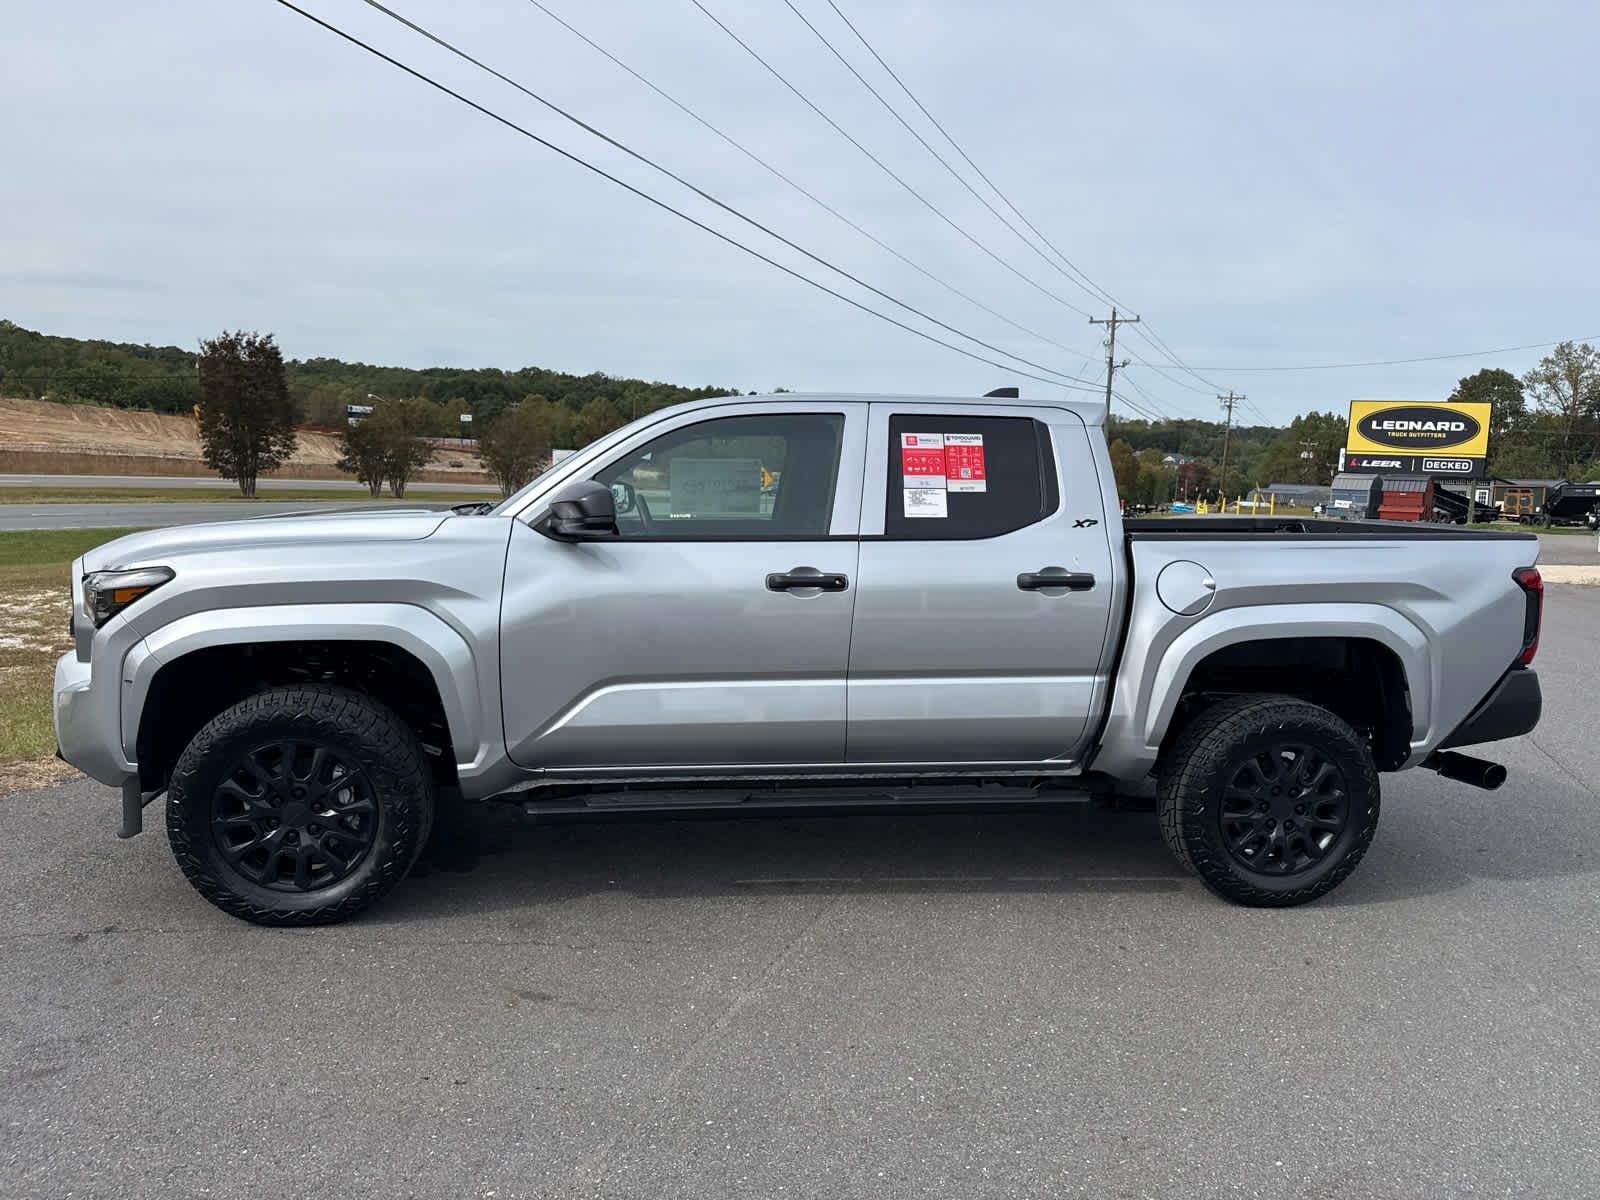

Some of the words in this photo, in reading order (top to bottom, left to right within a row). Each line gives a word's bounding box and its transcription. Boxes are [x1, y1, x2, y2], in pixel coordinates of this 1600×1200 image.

[1371, 420, 1465, 431] LEONARD
[1361, 460, 1402, 468] LEER
[1426, 461, 1469, 470] DECKED
